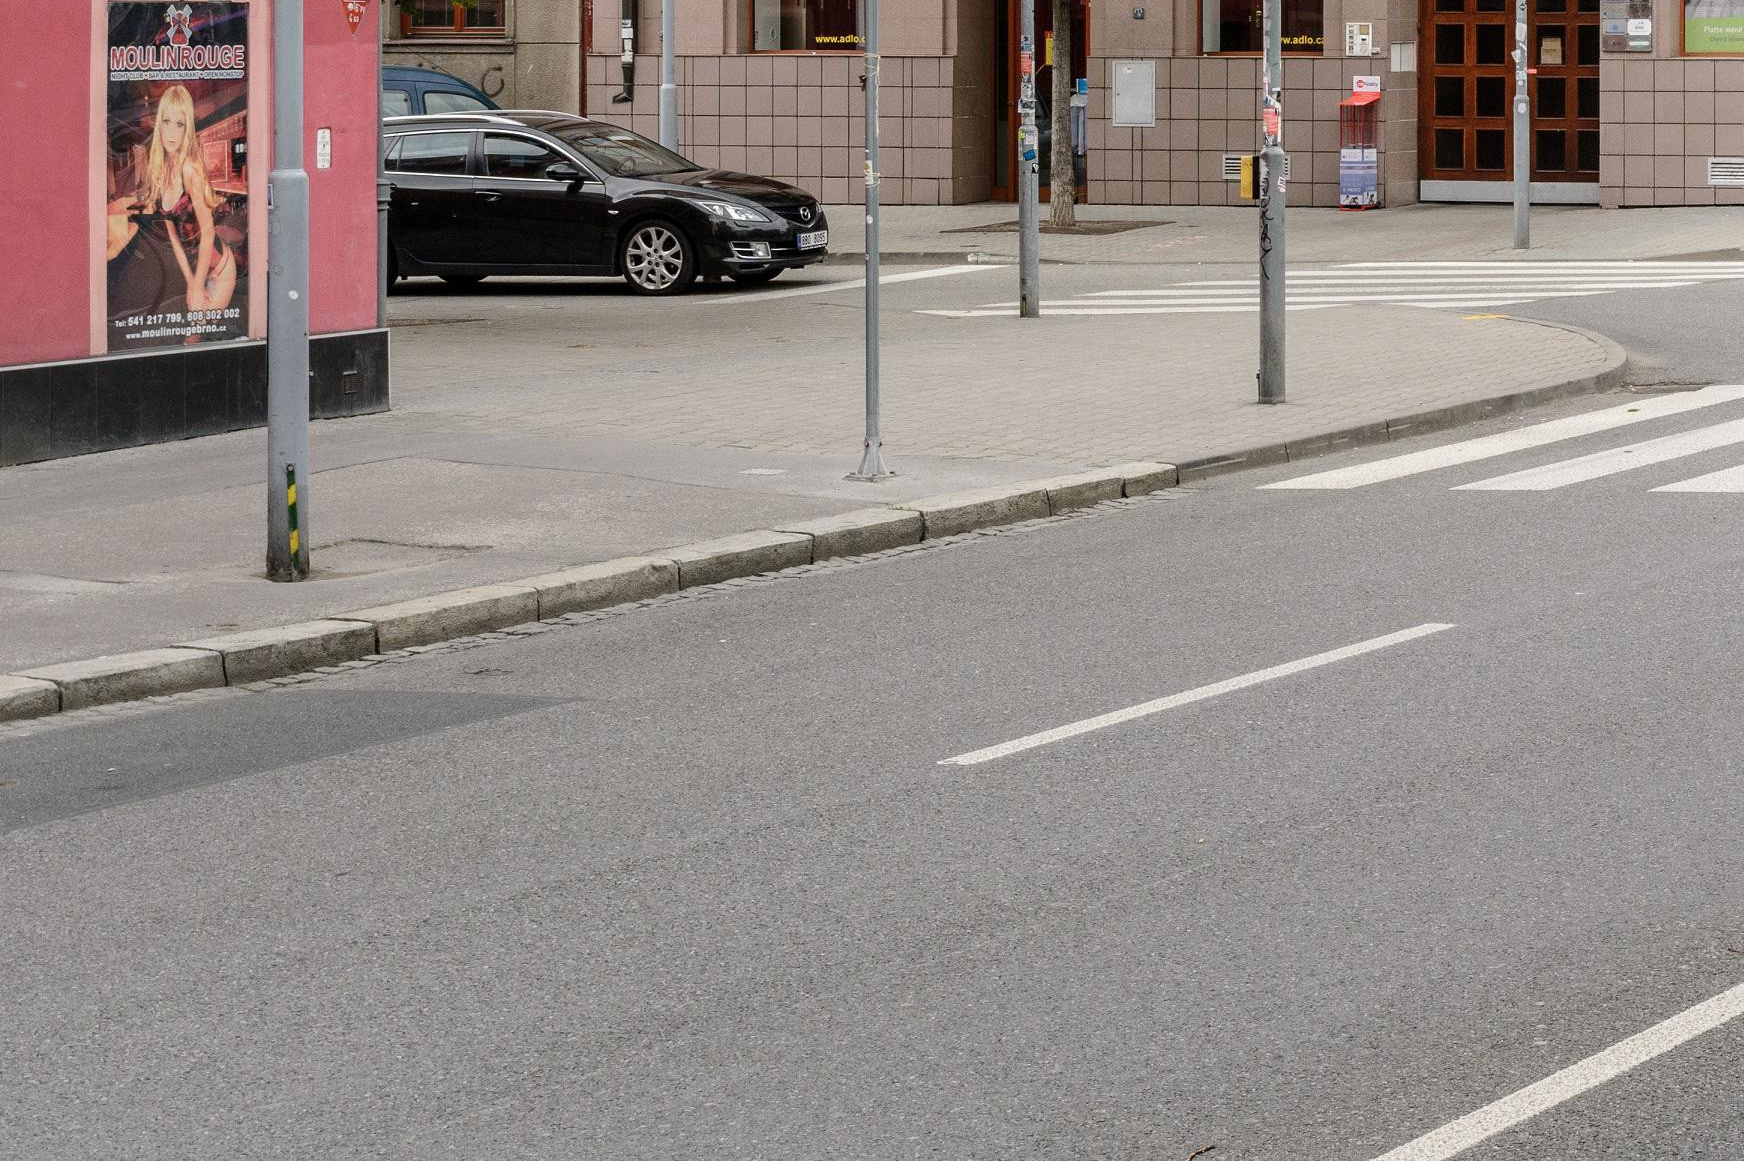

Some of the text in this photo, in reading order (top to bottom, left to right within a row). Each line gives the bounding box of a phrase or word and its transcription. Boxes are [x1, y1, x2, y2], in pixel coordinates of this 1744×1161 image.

[815, 34, 865, 44] www.adlo.c
[110, 44, 245, 70] MOULIN ROUGE
[111, 73, 129, 81] NIGHT
[129, 72, 144, 80] CLUB
[165, 71, 200, 79] RESTAURANT
[115, 308, 240, 328] Tel: 541 217 799, 608 302 002
[126, 324, 227, 339] www.moulinrougebrno.cz
